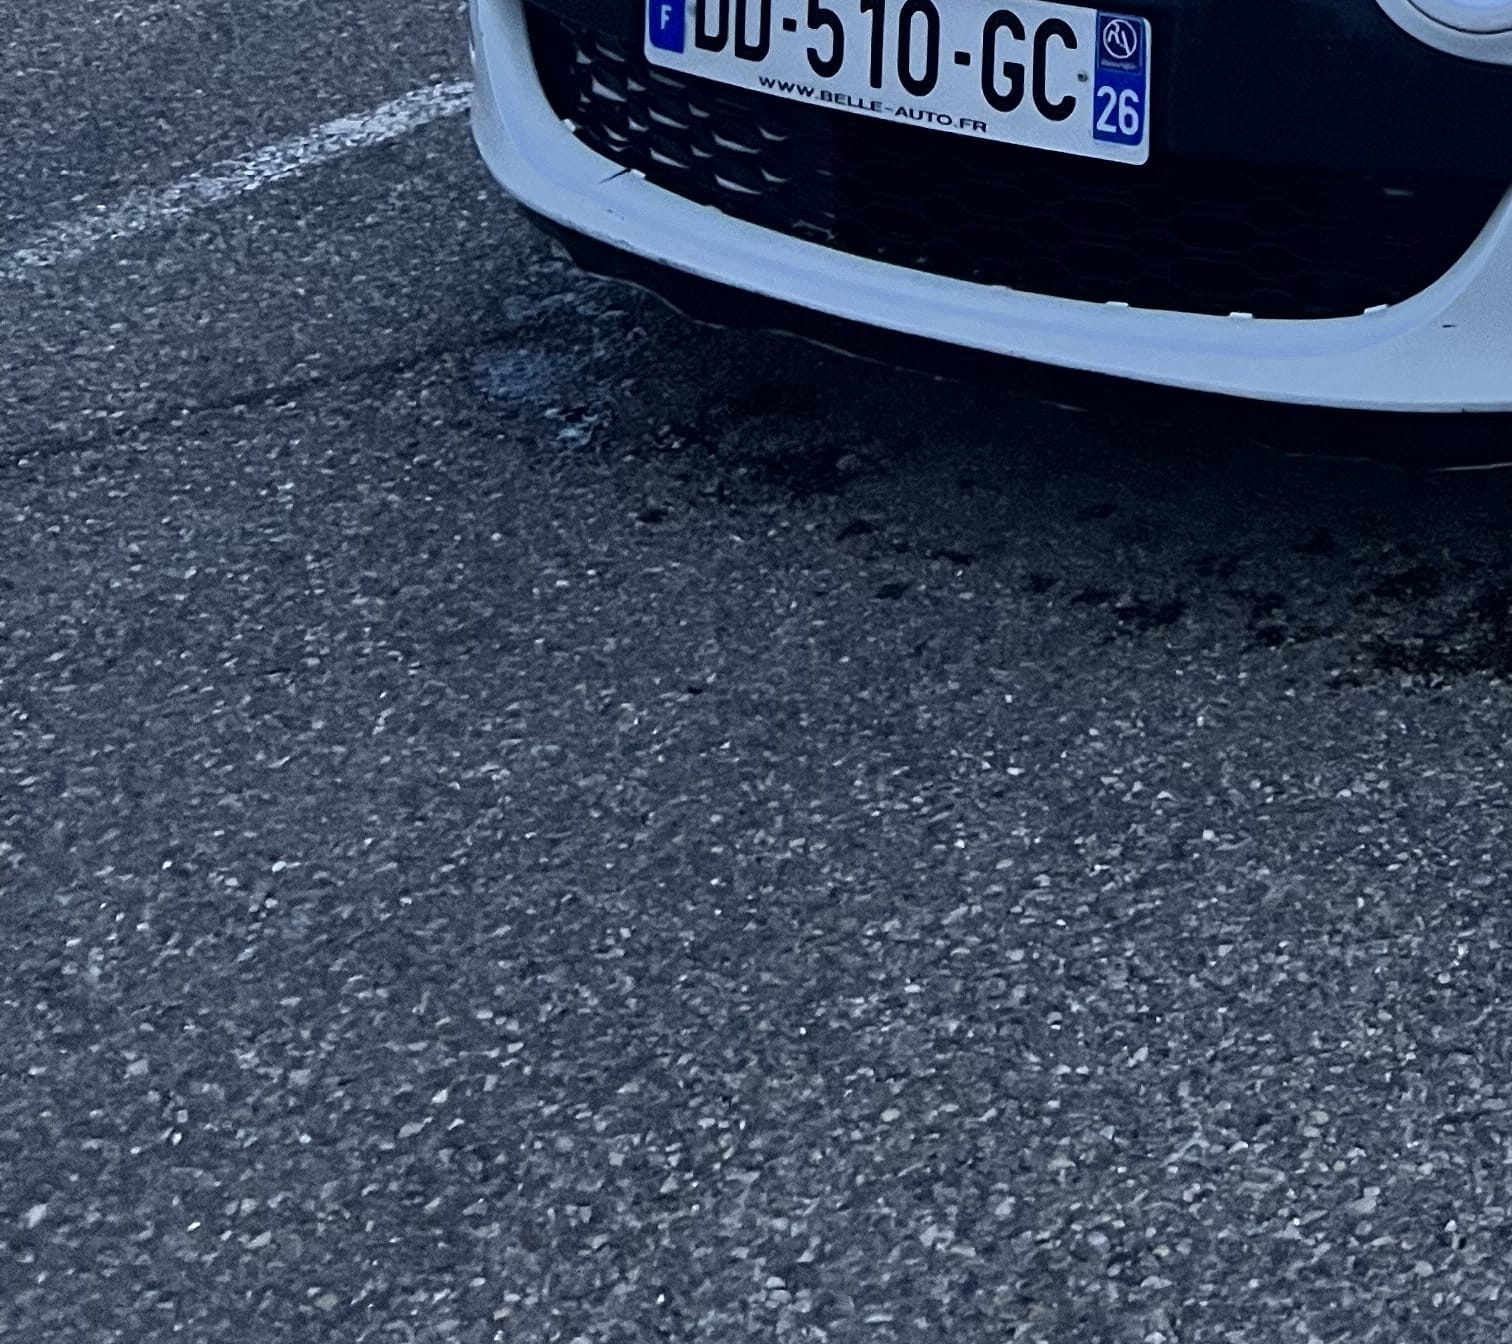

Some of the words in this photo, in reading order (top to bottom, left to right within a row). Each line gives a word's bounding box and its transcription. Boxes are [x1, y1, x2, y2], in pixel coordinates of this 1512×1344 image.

[659, 3, 673, 31] F
[758, 75, 988, 133] WWW.BELLE-AUTO.FR
[1096, 85, 1140, 136] 26
